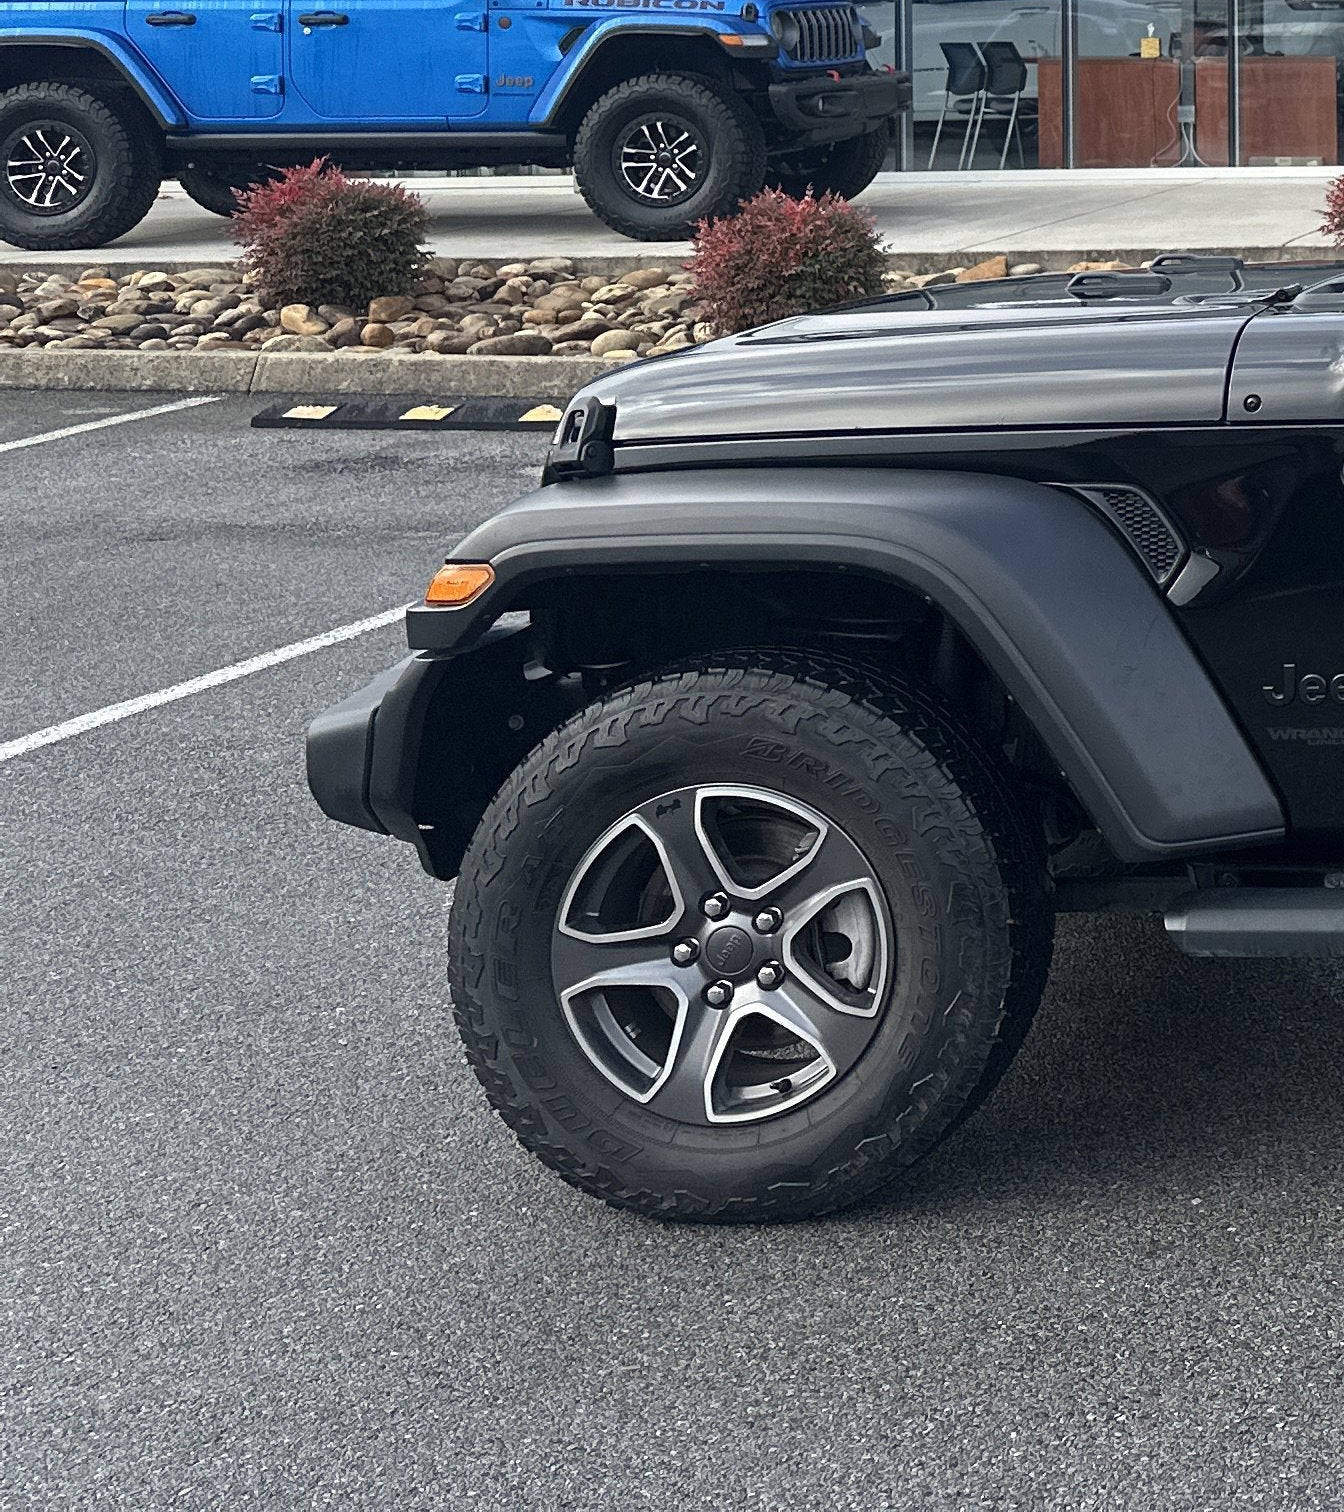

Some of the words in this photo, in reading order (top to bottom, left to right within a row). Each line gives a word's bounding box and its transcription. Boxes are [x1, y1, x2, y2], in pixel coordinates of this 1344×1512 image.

[495, 73, 534, 89] Jeep
[740, 736, 944, 1071] BRIDGESTONE
[717, 934, 742, 966] Jeep
